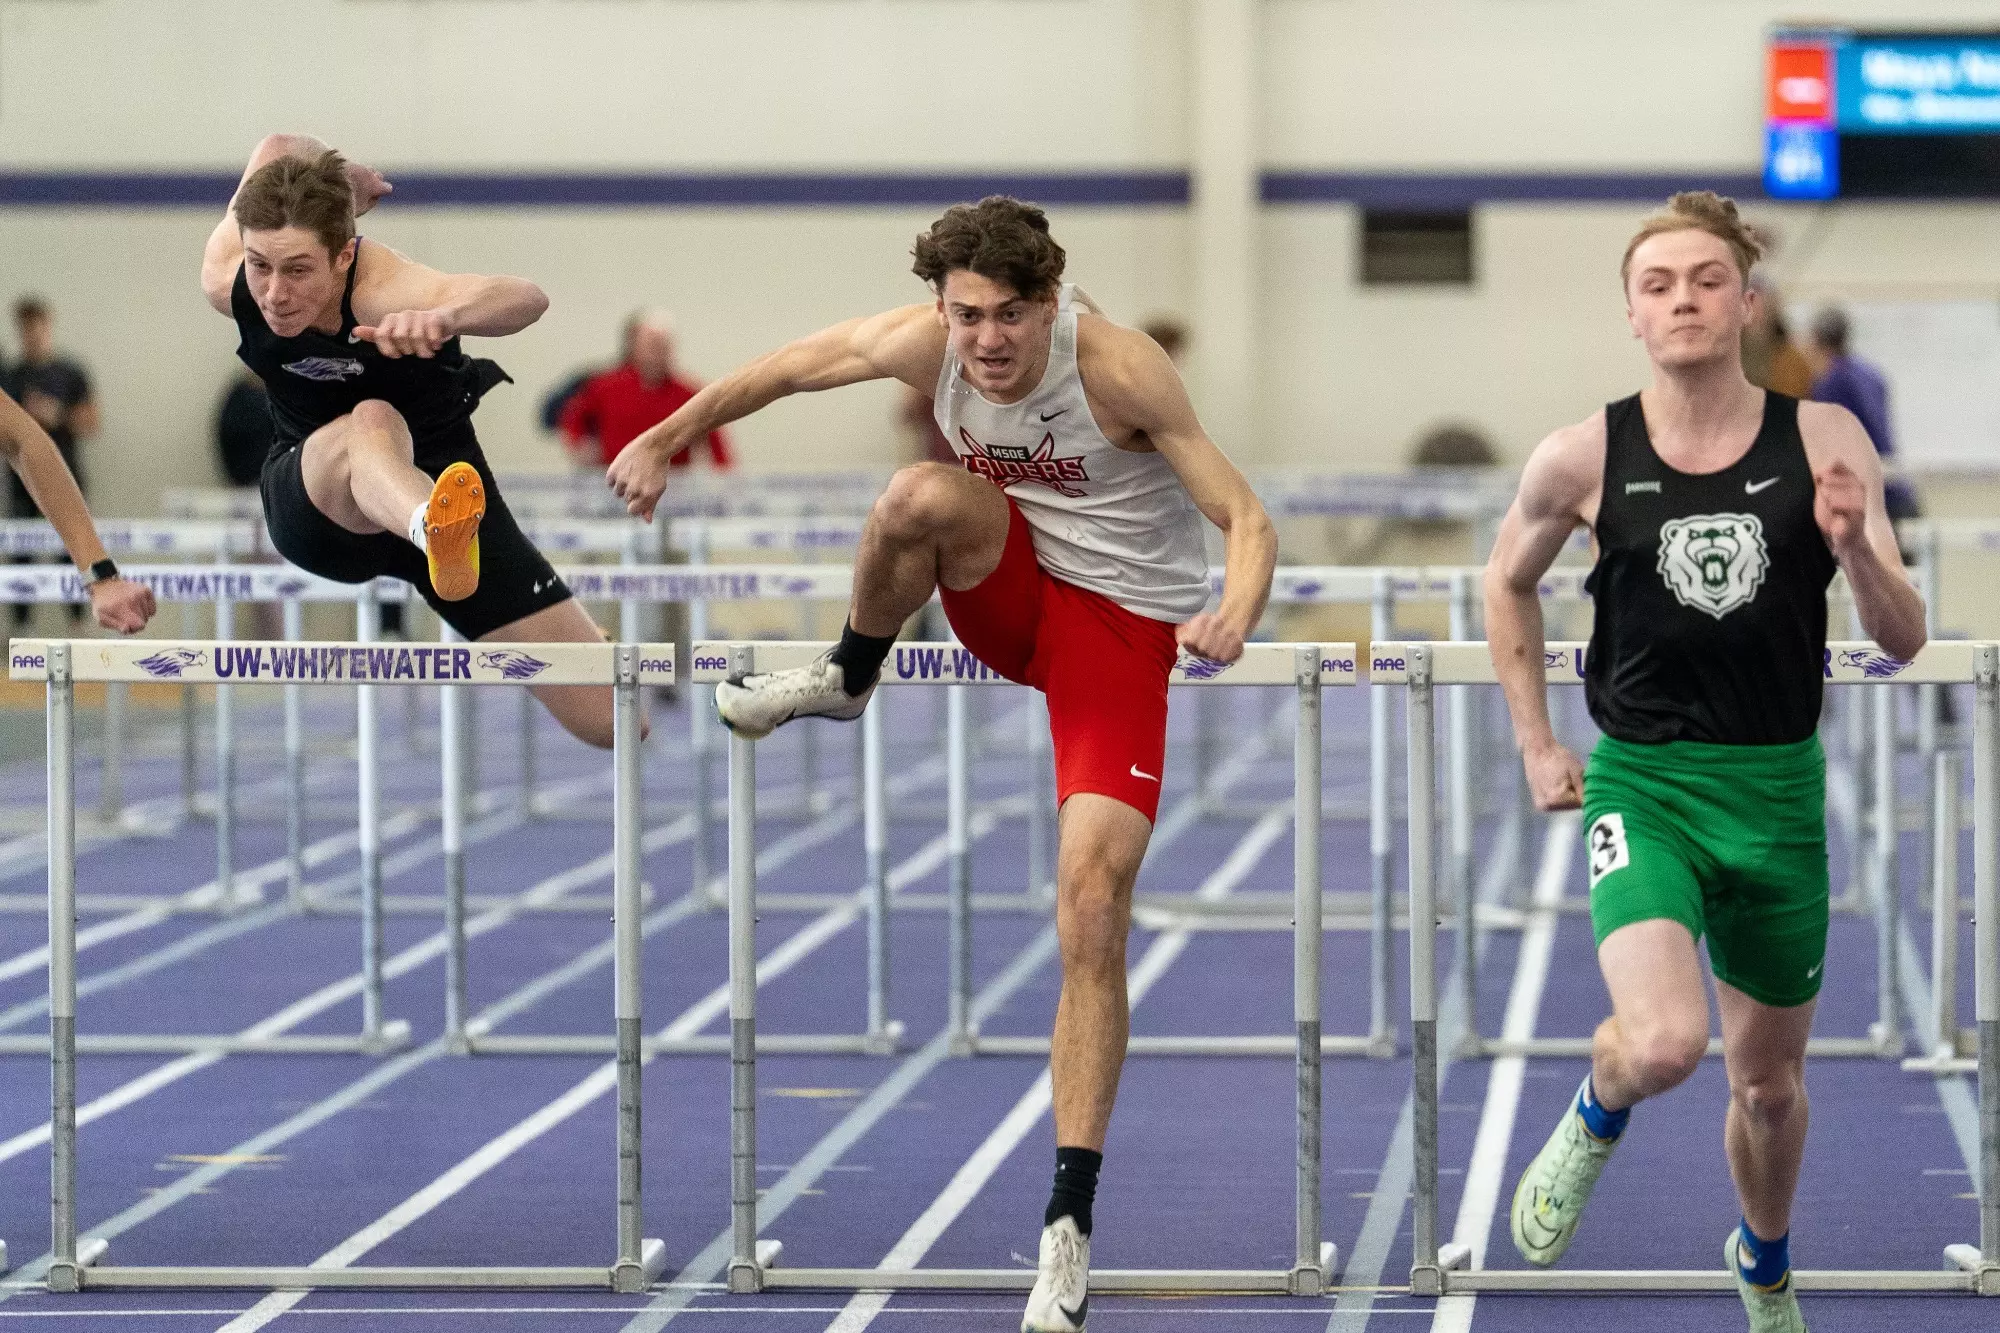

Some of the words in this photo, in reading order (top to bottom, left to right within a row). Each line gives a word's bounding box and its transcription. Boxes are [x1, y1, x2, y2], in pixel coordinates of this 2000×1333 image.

[991, 446, 1027, 460] MSOE
[962, 454, 1087, 482] AIDERS
[214, 647, 473, 680] UW-WHITEWATER
